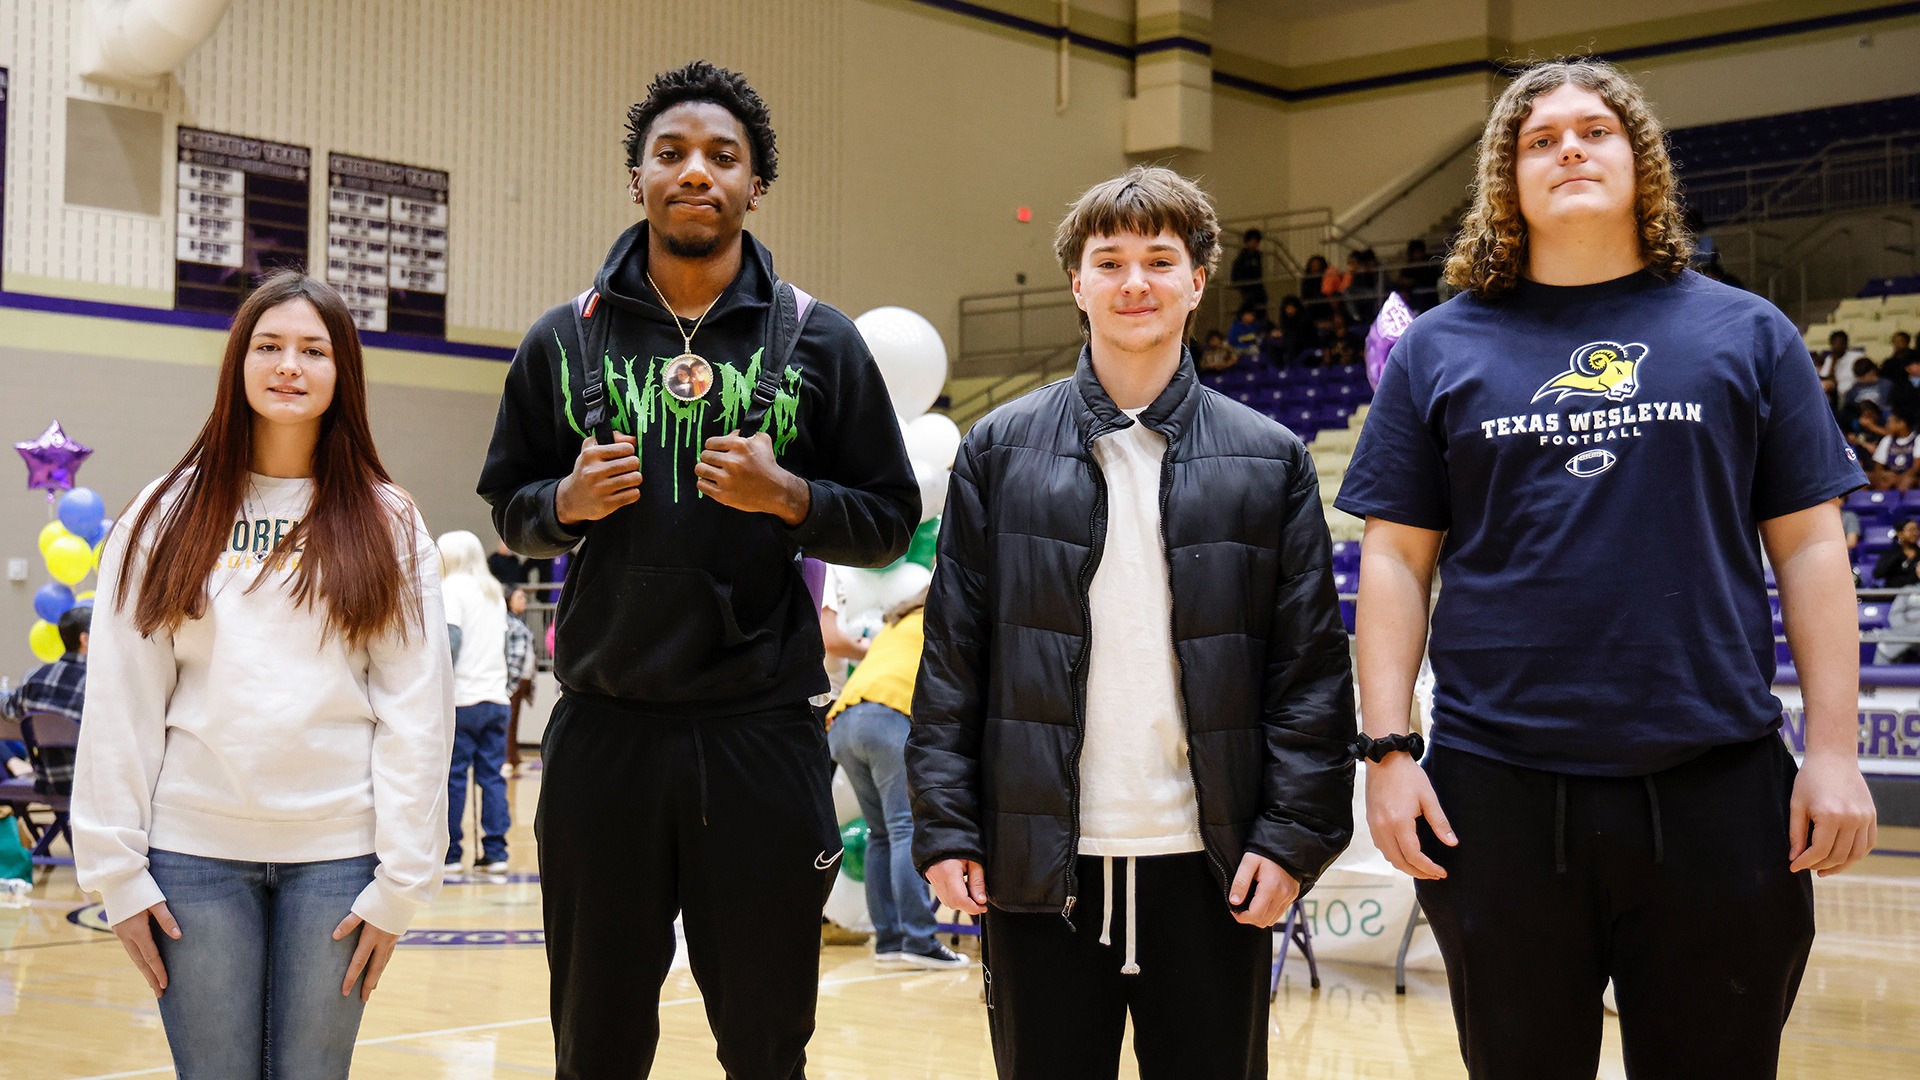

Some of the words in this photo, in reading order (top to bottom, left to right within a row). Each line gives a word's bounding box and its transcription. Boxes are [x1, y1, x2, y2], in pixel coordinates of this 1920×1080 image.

[1481, 413, 1559, 439] TEXAS
[1569, 402, 1702, 432] WESLEYAN
[1539, 426, 1642, 446] FOOTBALL
